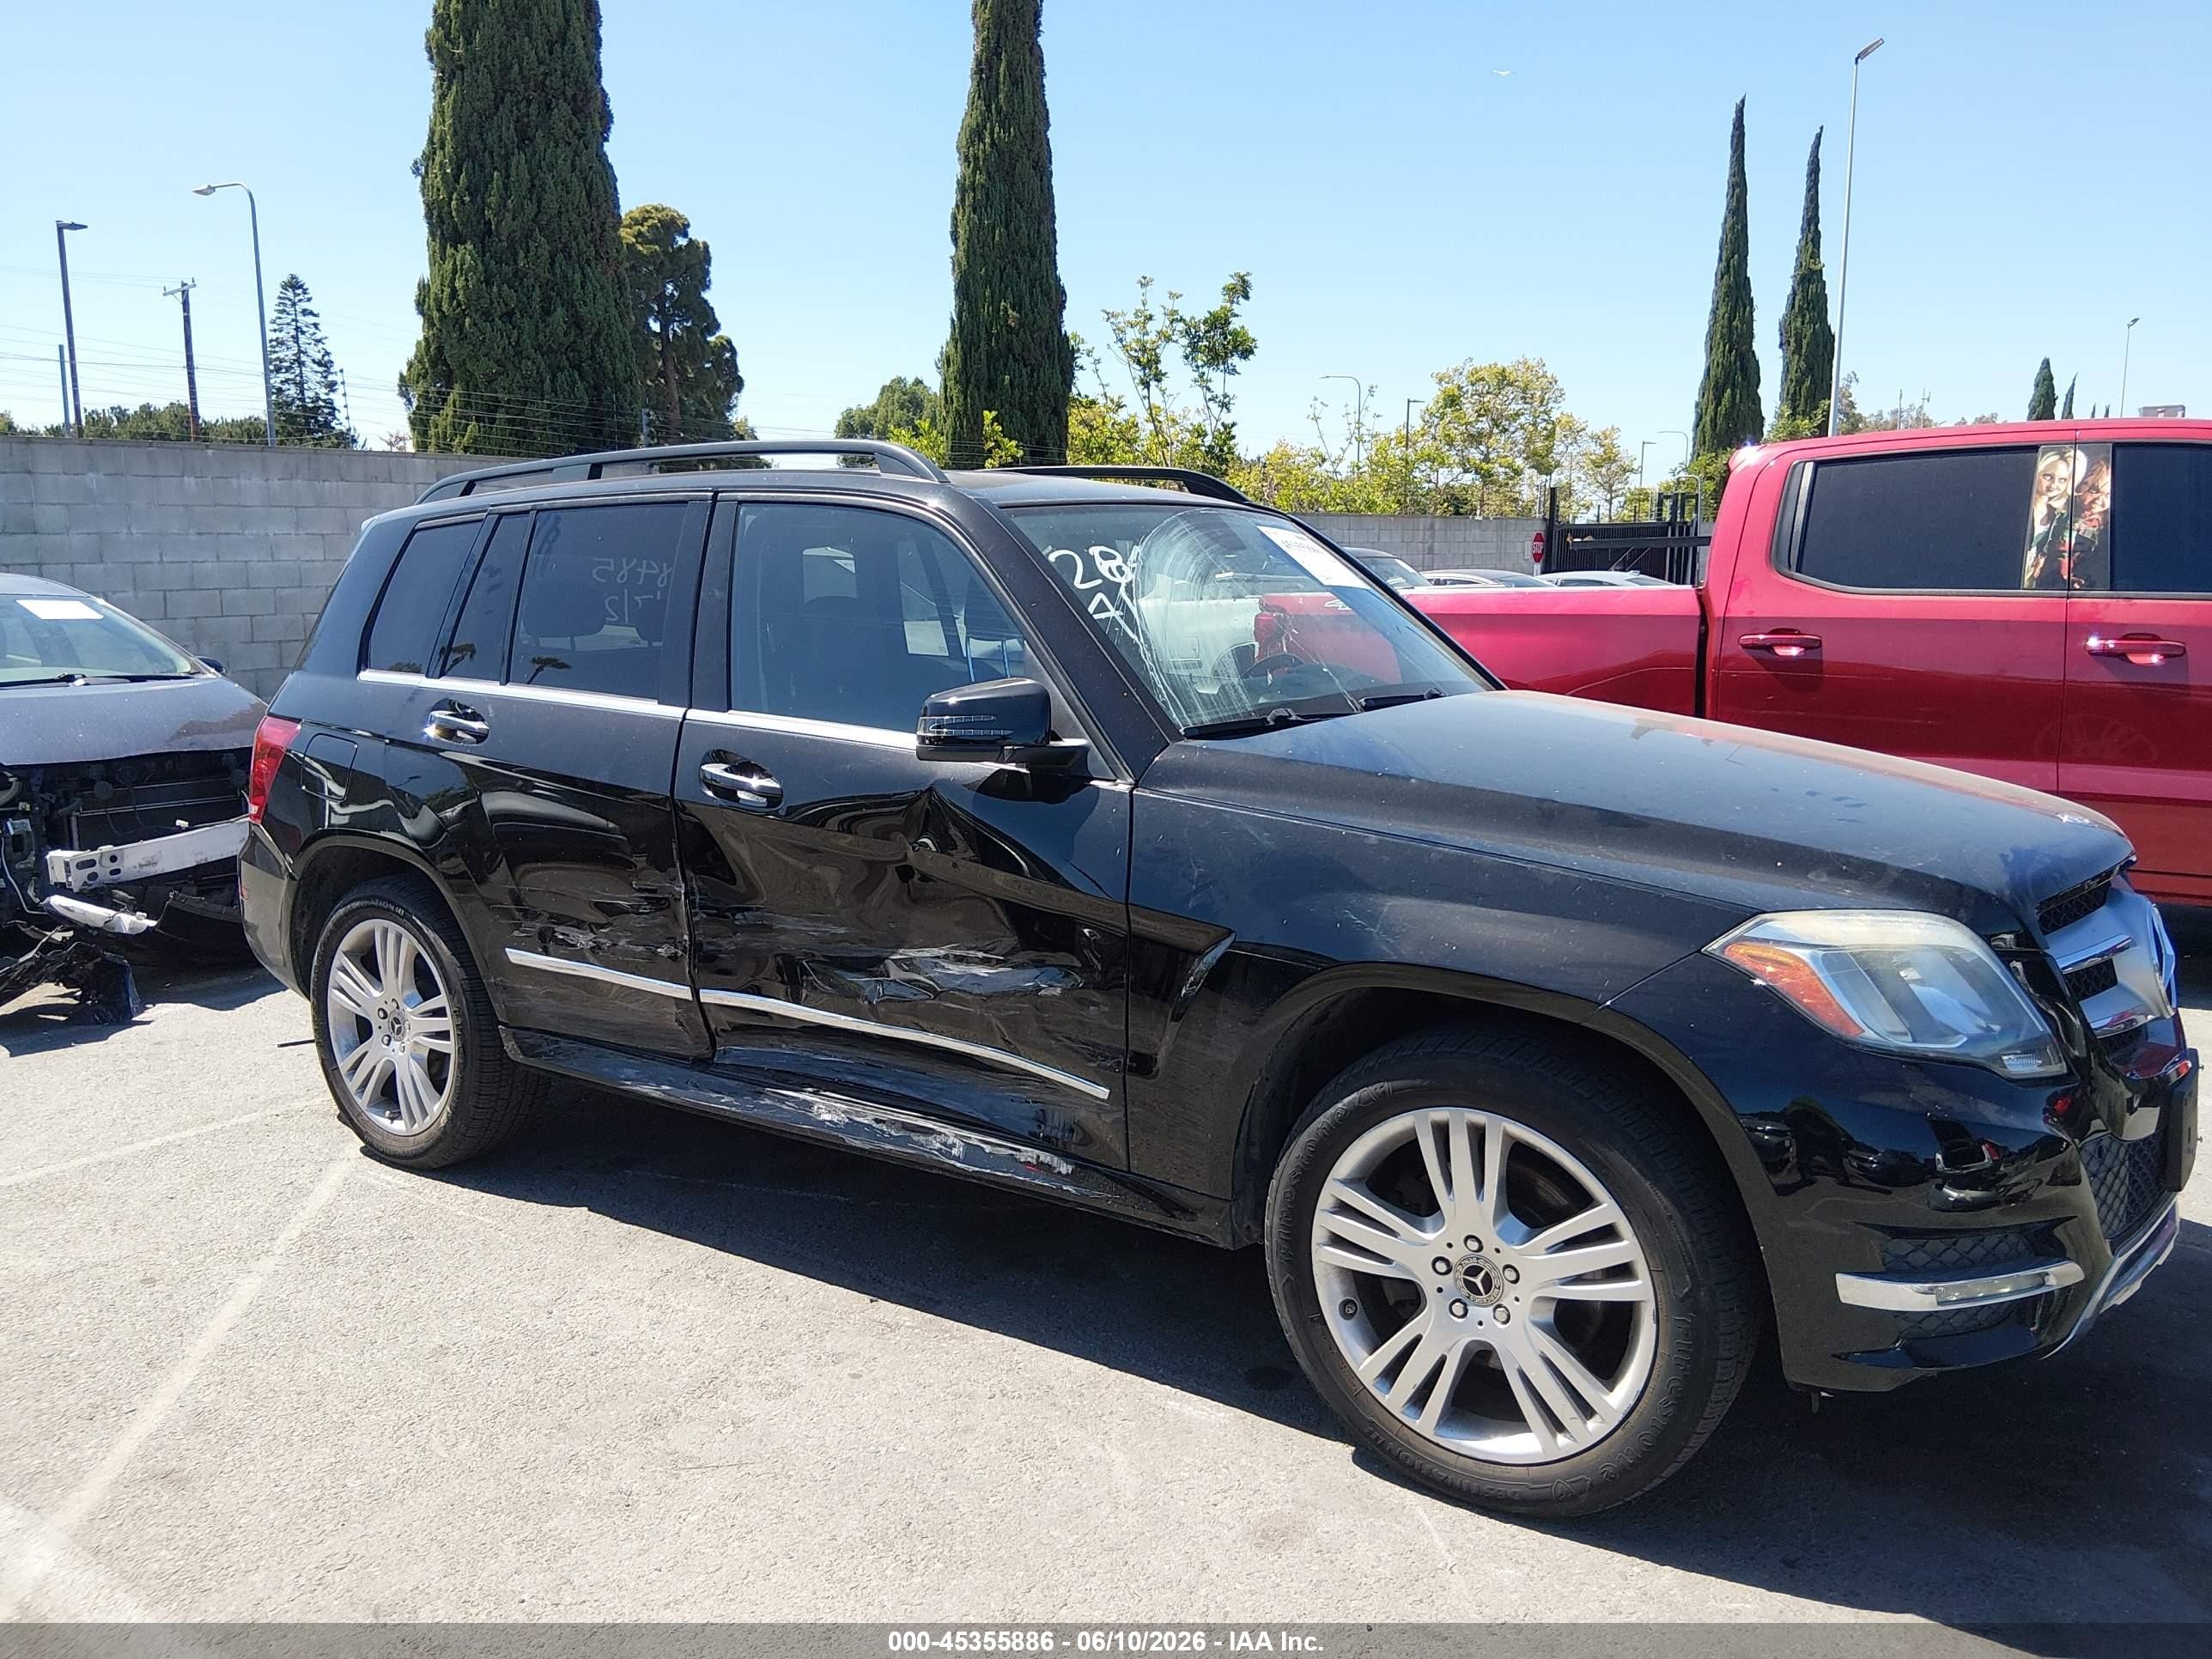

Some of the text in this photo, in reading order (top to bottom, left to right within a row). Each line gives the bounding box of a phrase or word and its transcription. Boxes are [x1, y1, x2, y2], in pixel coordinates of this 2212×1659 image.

[1533, 542, 1544, 554] STOP
[1278, 1105, 1350, 1265] Firestone
[1461, 1256, 1478, 1267] BENZ
[1599, 1311, 1697, 1483] Firestone
